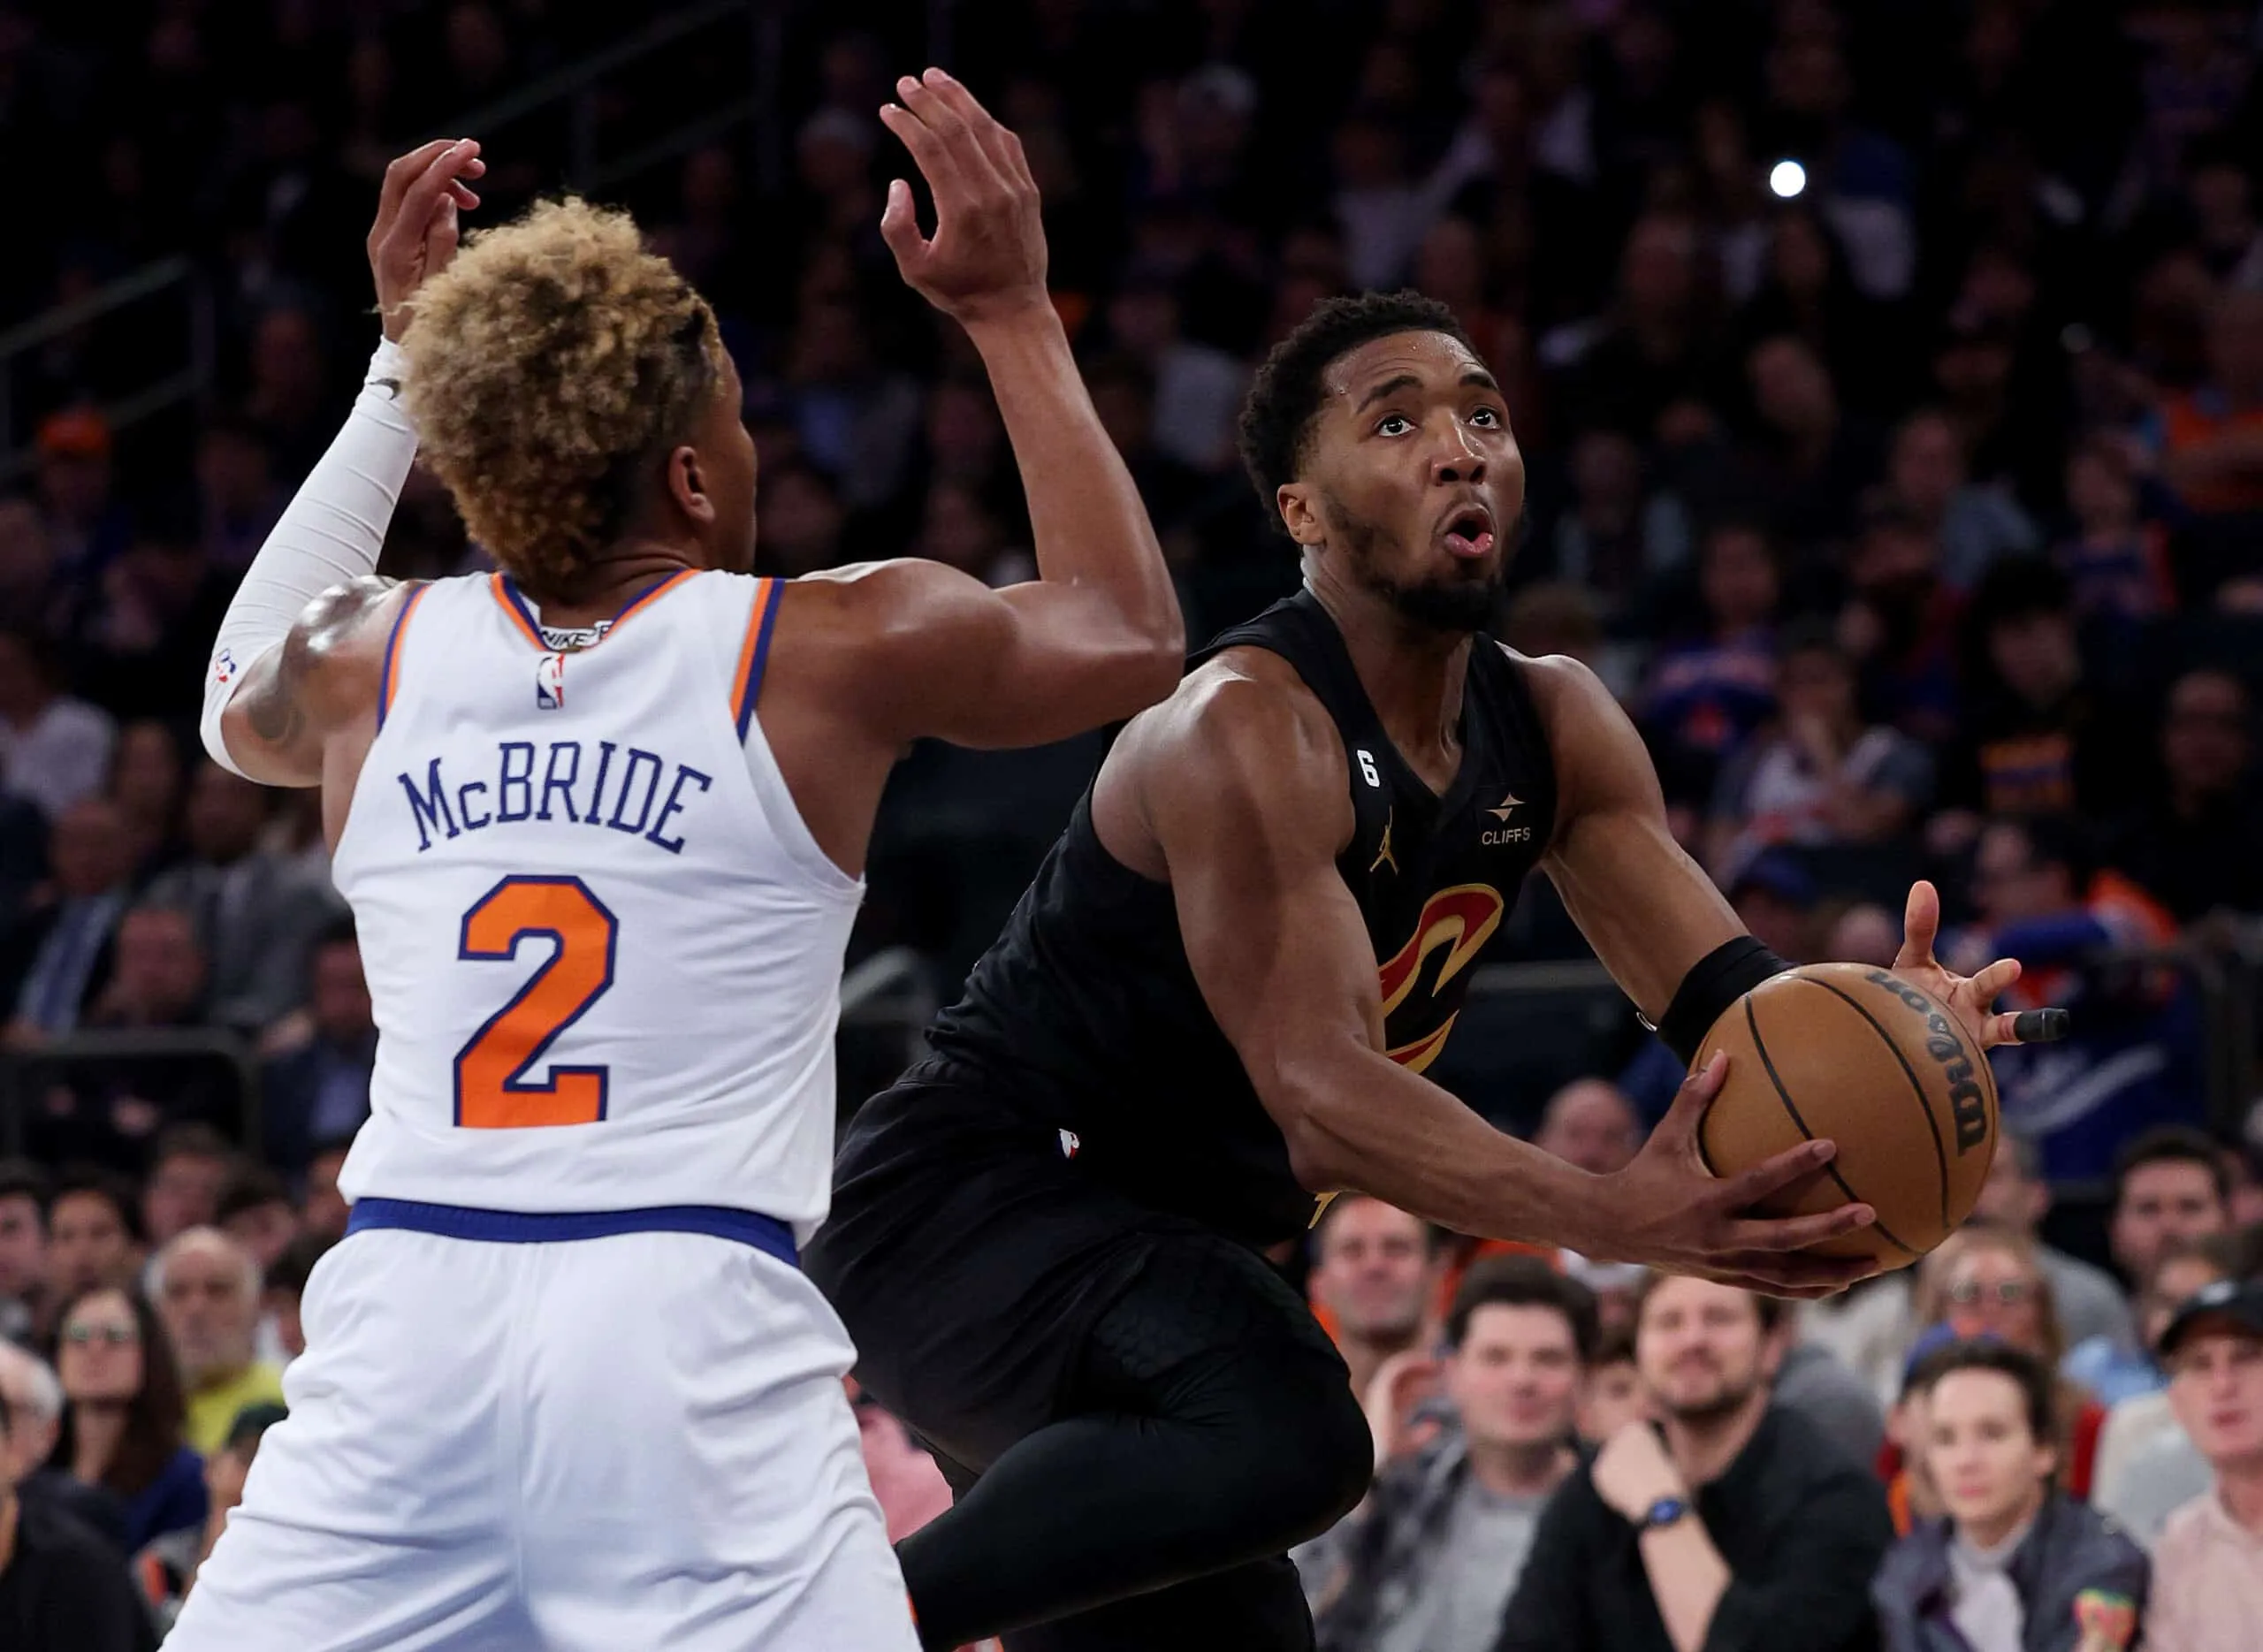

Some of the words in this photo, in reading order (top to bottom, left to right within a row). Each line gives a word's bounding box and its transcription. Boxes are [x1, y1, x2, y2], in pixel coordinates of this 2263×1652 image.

[398, 742, 712, 855] McBRIDE
[1357, 750, 1380, 788] 6
[1482, 827, 1531, 845] CLIFFS
[453, 875, 618, 1129] 2
